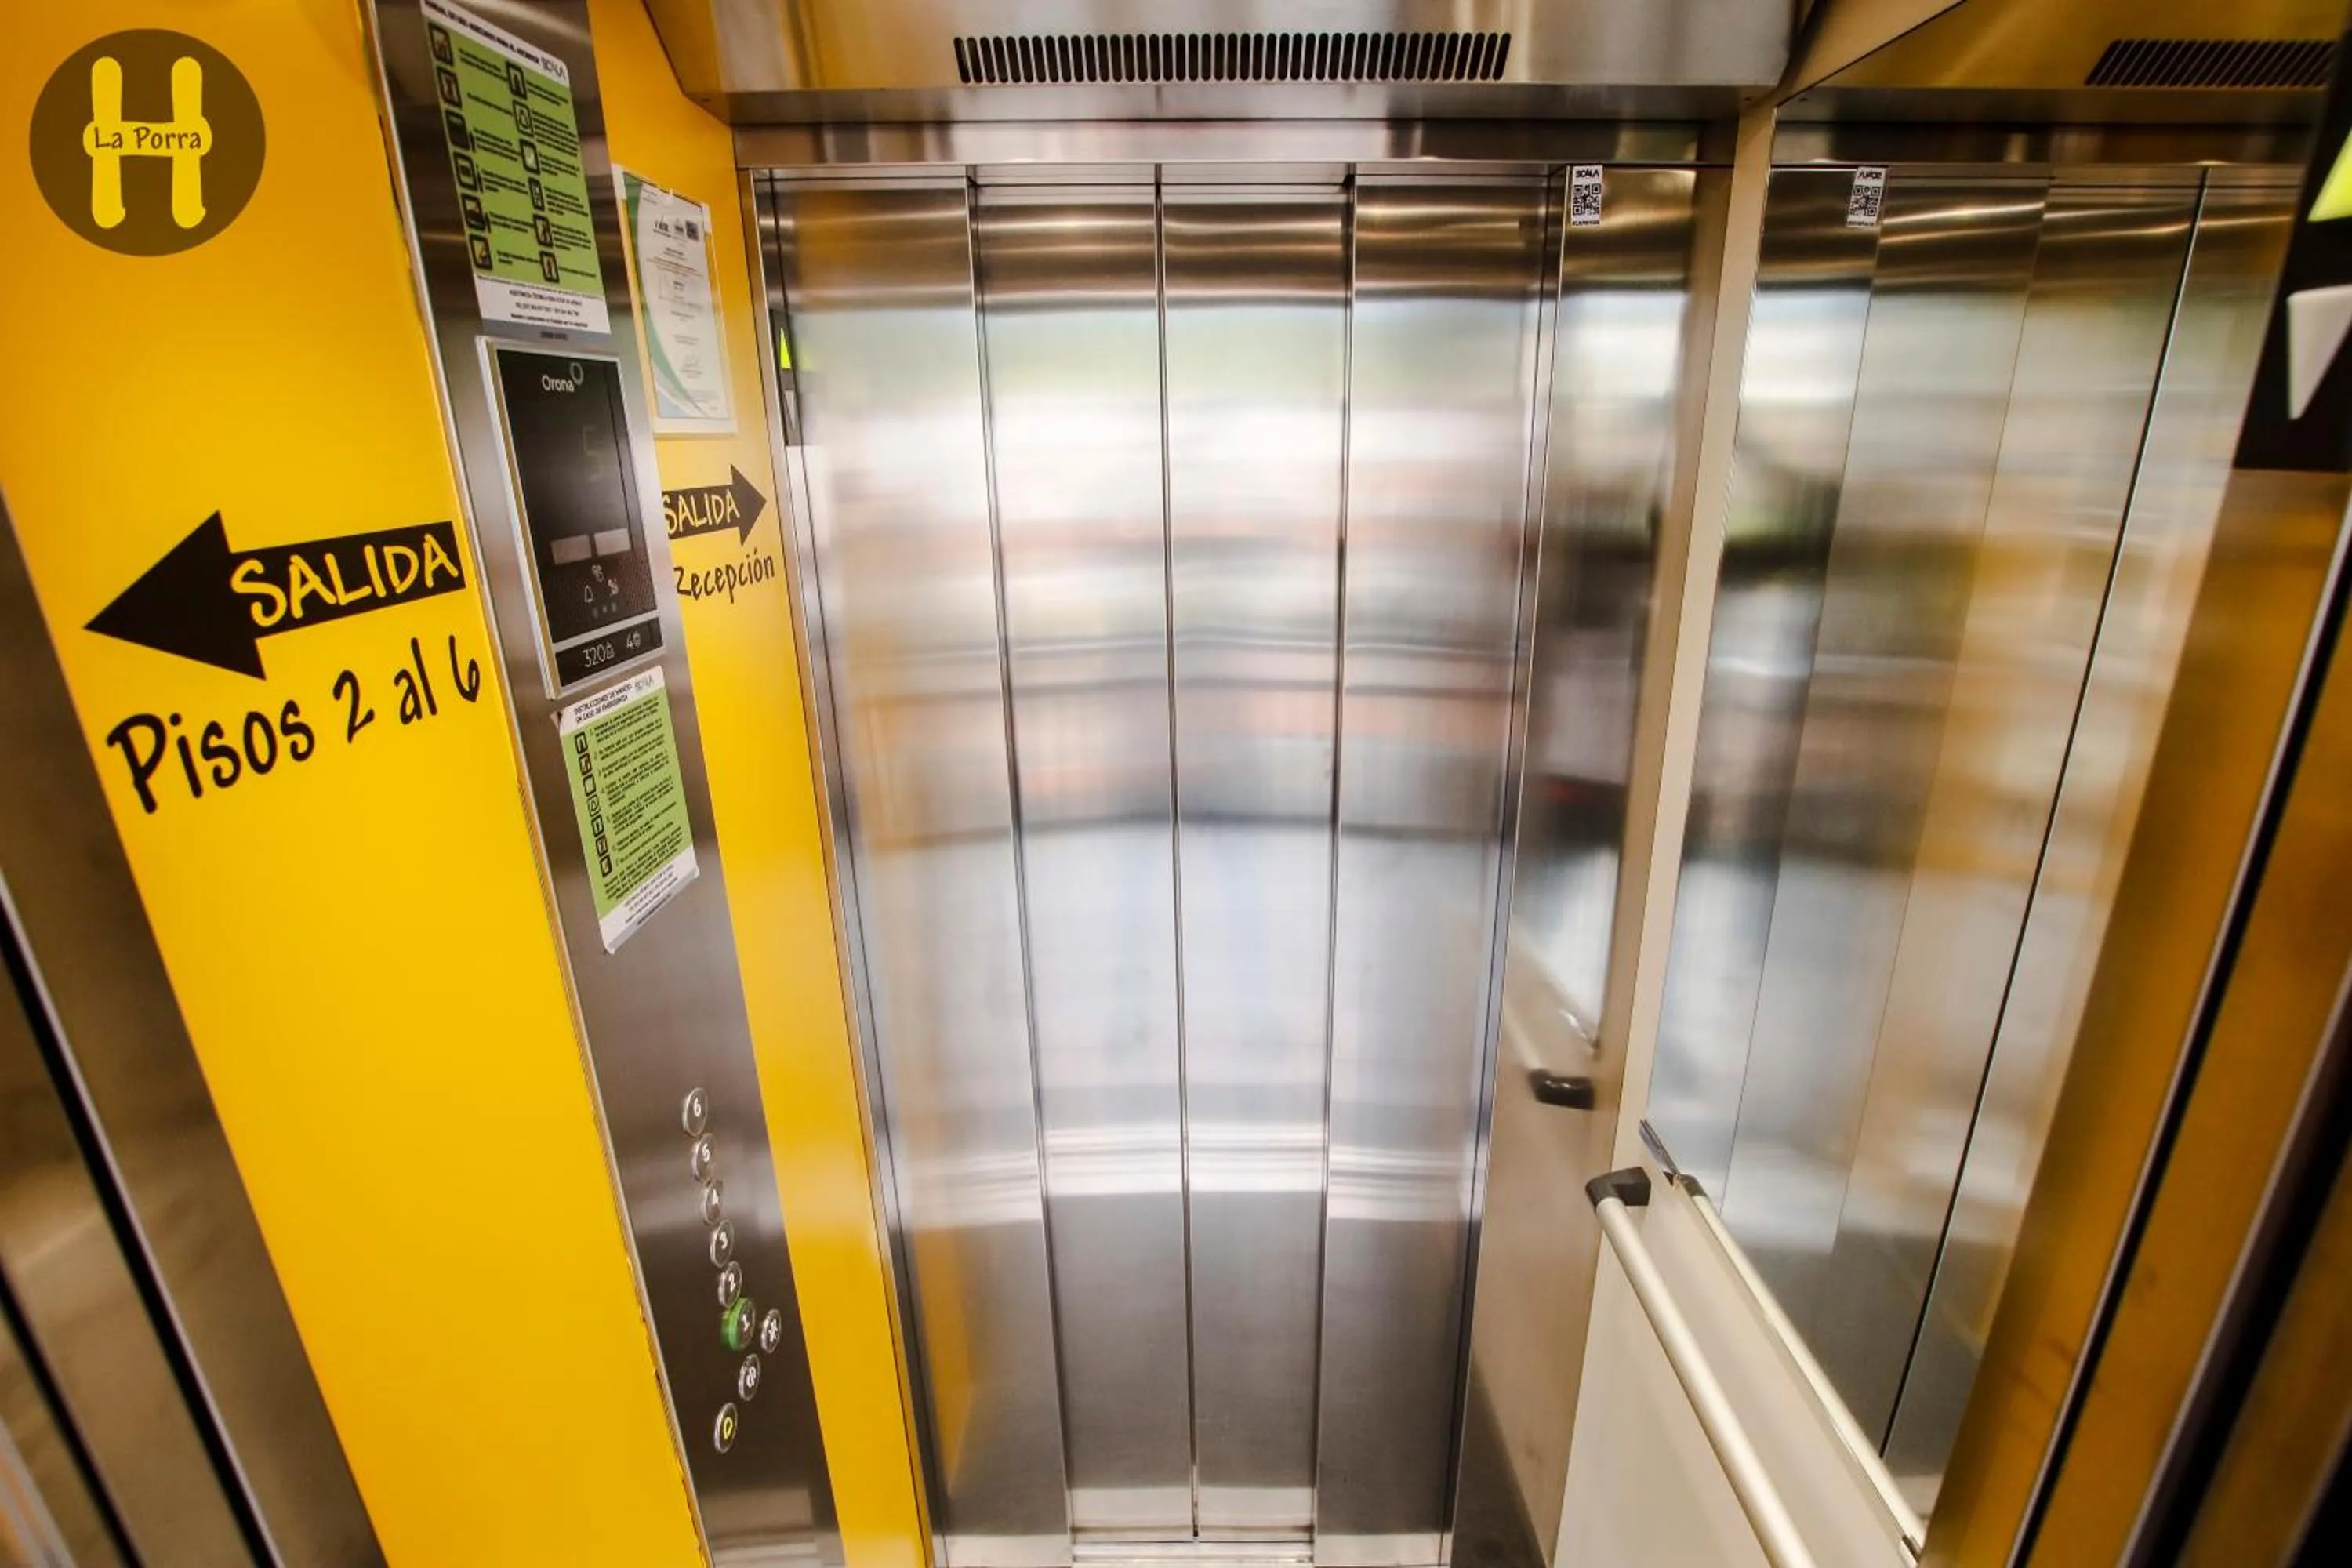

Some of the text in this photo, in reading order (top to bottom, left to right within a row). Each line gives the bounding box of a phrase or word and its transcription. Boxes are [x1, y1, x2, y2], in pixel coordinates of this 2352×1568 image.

[542, 374, 575, 392] Orona
[661, 488, 741, 534] SALIDA
[231, 533, 459, 628] SALIDA
[582, 643, 607, 668] 320
[106, 634, 481, 815] Pisos 2 al 6
[693, 1098, 702, 1118] 6
[702, 1142, 711, 1163] 5
[728, 1272, 736, 1293] 2
